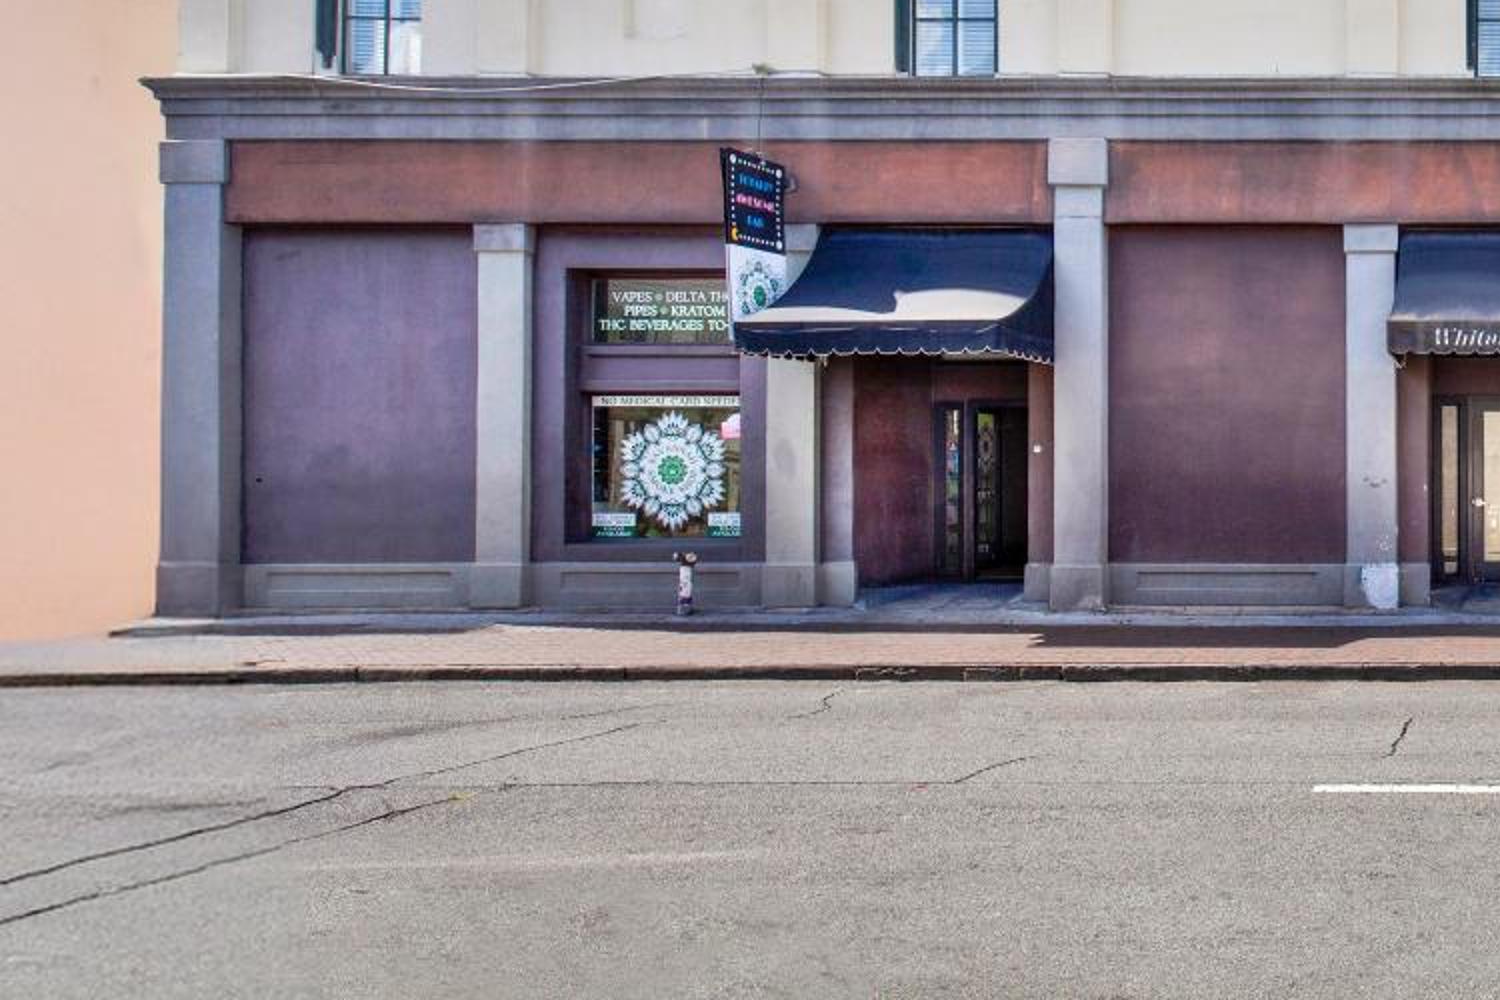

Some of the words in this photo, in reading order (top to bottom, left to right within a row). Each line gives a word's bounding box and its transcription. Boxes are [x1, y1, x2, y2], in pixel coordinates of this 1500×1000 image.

[612, 291, 653, 302] VAPES
[665, 291, 706, 302] DELTA
[624, 305, 657, 317] PIPES
[671, 305, 726, 317] KRATOM
[600, 319, 626, 331] THC
[629, 319, 705, 331] BEVERAGES
